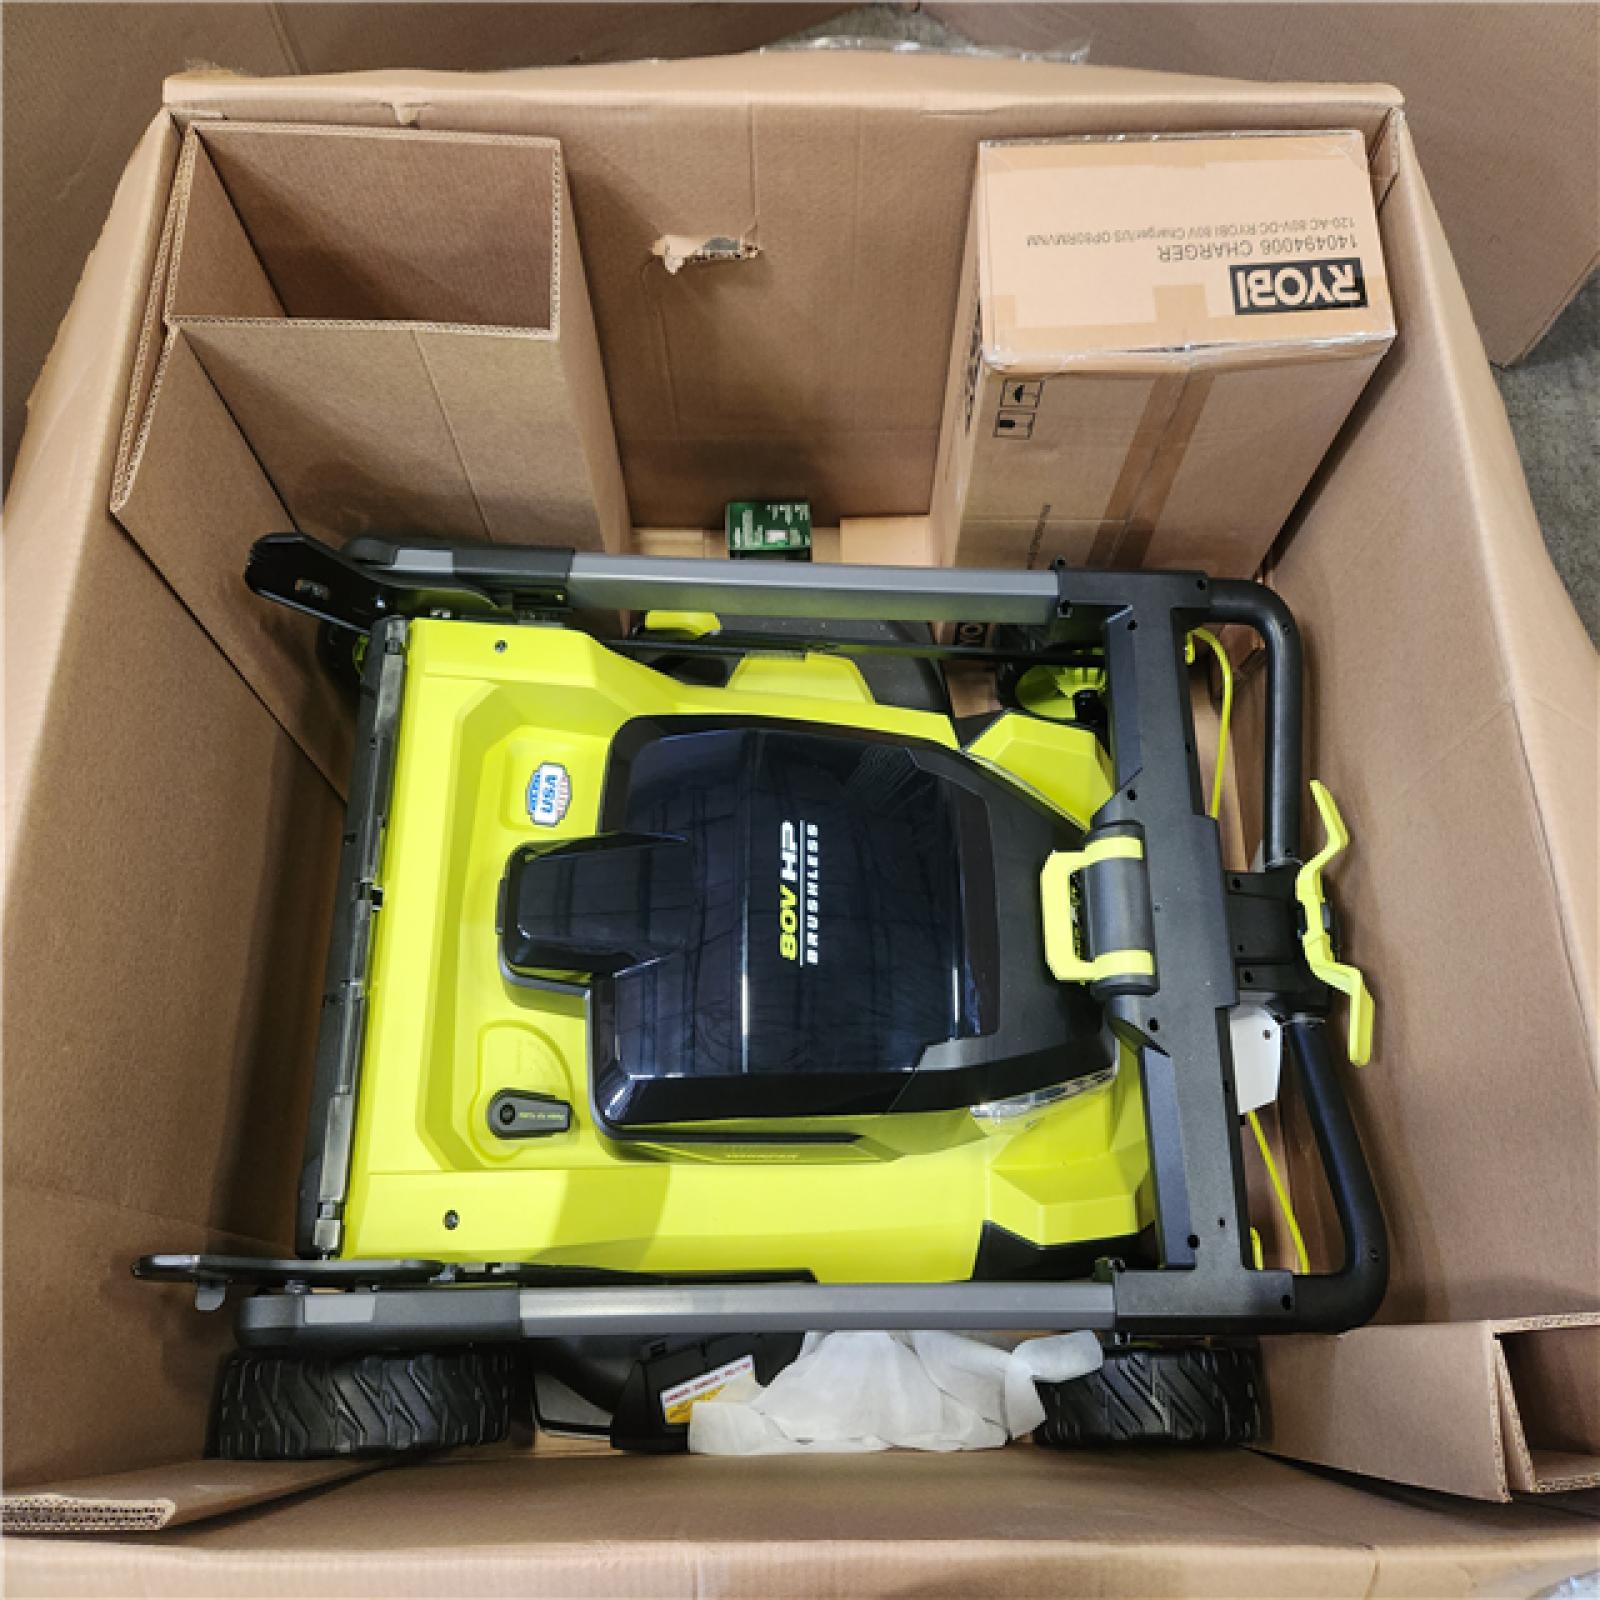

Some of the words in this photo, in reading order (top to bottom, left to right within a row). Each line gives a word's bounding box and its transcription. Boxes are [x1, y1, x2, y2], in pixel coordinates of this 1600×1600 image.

[1157, 241, 1253, 262] CHARGER
[1236, 264, 1360, 307] RYOBI
[541, 775, 557, 813] USA
[780, 820, 798, 882] HP
[806, 824, 819, 965] BRUSHLESS
[779, 884, 798, 961] 80V
